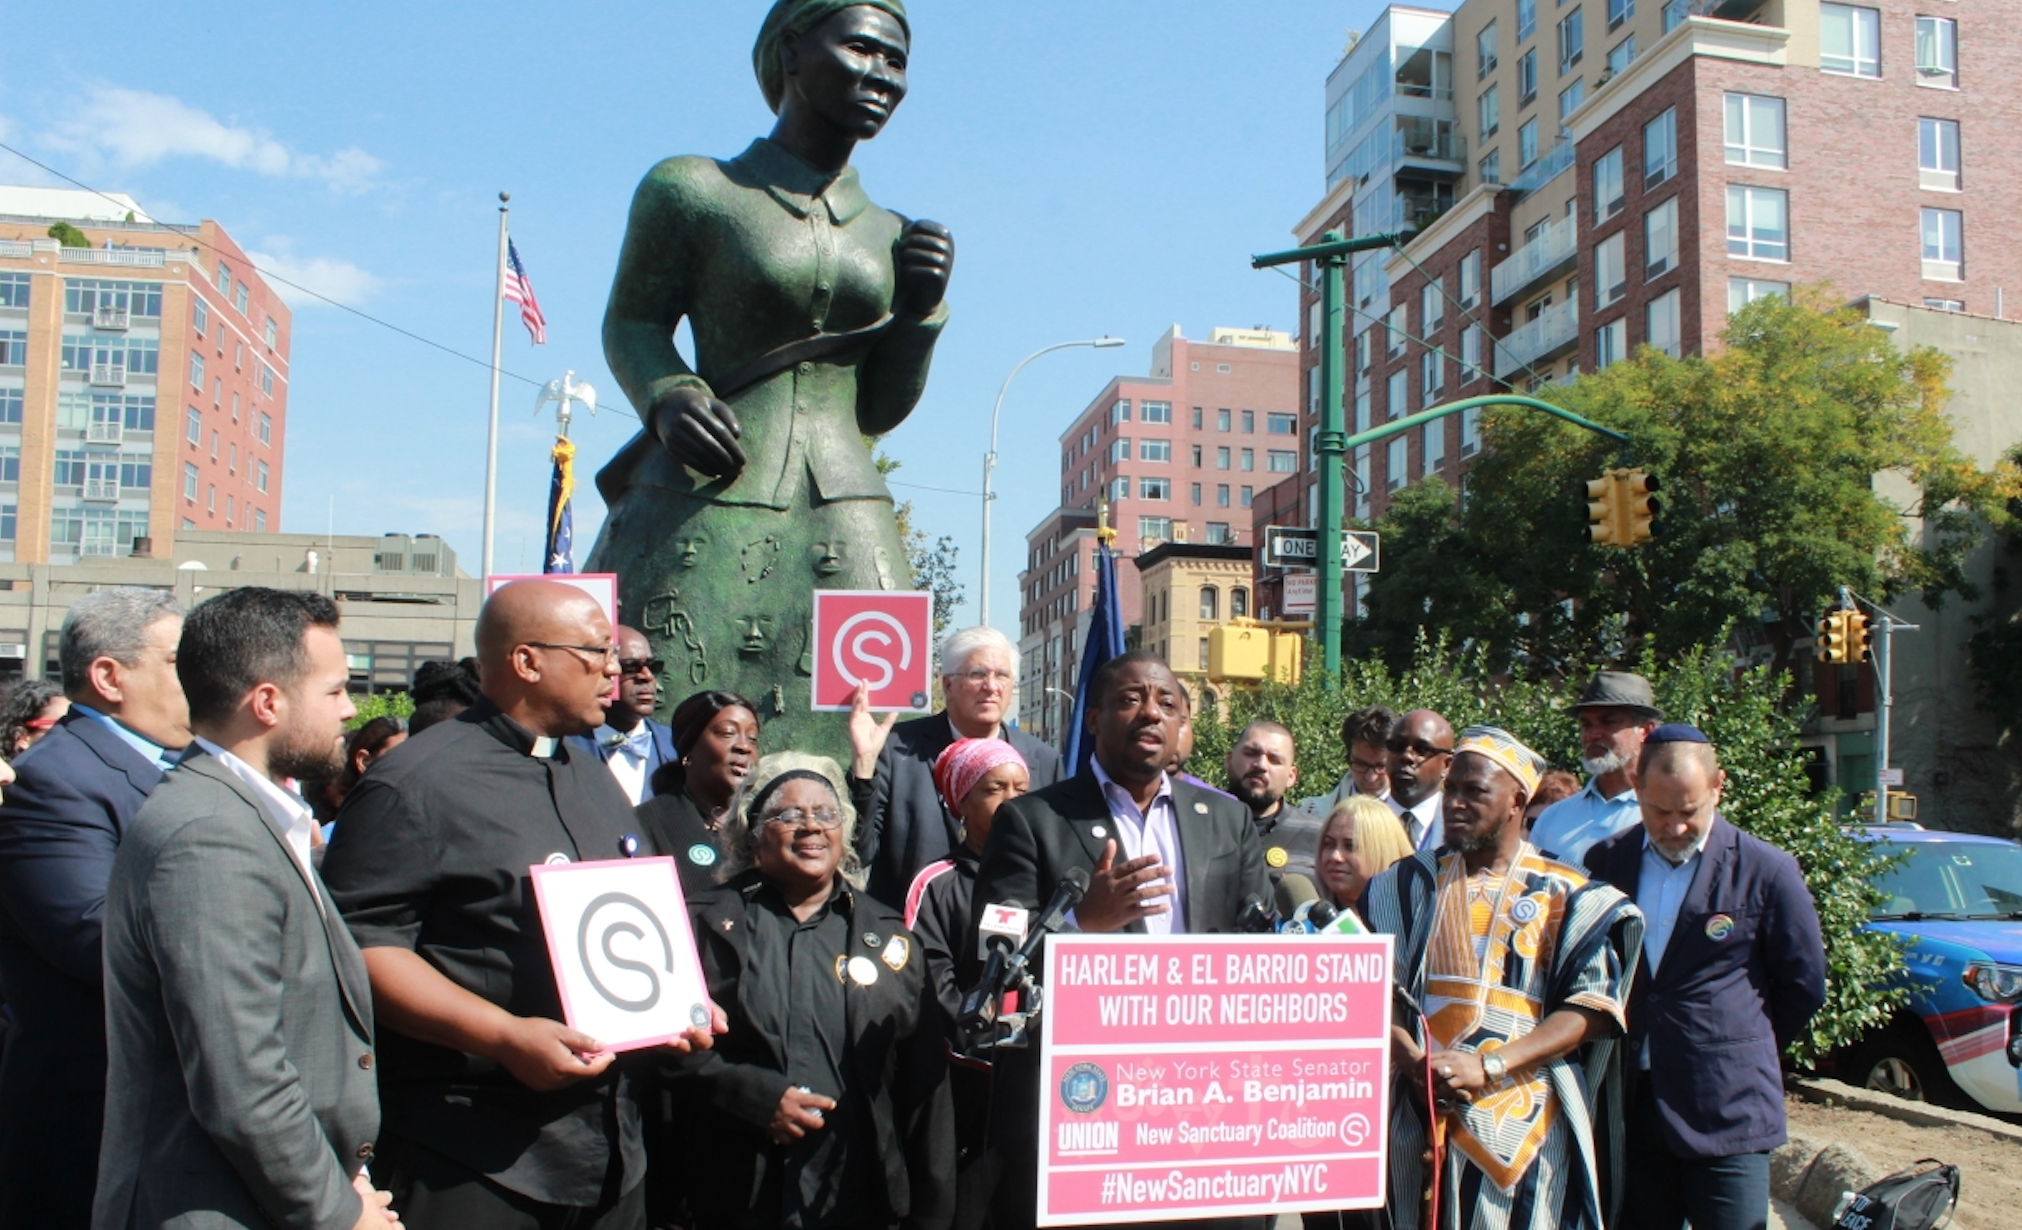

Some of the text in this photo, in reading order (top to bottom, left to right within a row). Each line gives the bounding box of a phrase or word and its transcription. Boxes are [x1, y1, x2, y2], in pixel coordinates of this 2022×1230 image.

[1283, 540, 1361, 558] ONE AY
[1287, 587, 1313, 596] Anytime
[1060, 953, 1384, 986] HARLEM & EL BARRIO STAND
[1099, 993, 1348, 1027] WITH OUR NEIGHBORS
[1117, 1058, 1371, 1082] New York State Senator
[1116, 1077, 1373, 1108] Brian A. Benjamin
[1058, 1121, 1119, 1150] UNION
[1136, 1123, 1173, 1146] New
[1178, 1120, 1263, 1147] Sanctuary
[1267, 1118, 1337, 1141] Coalition
[1101, 1163, 1329, 1204] #NewSanctuaryNYC
